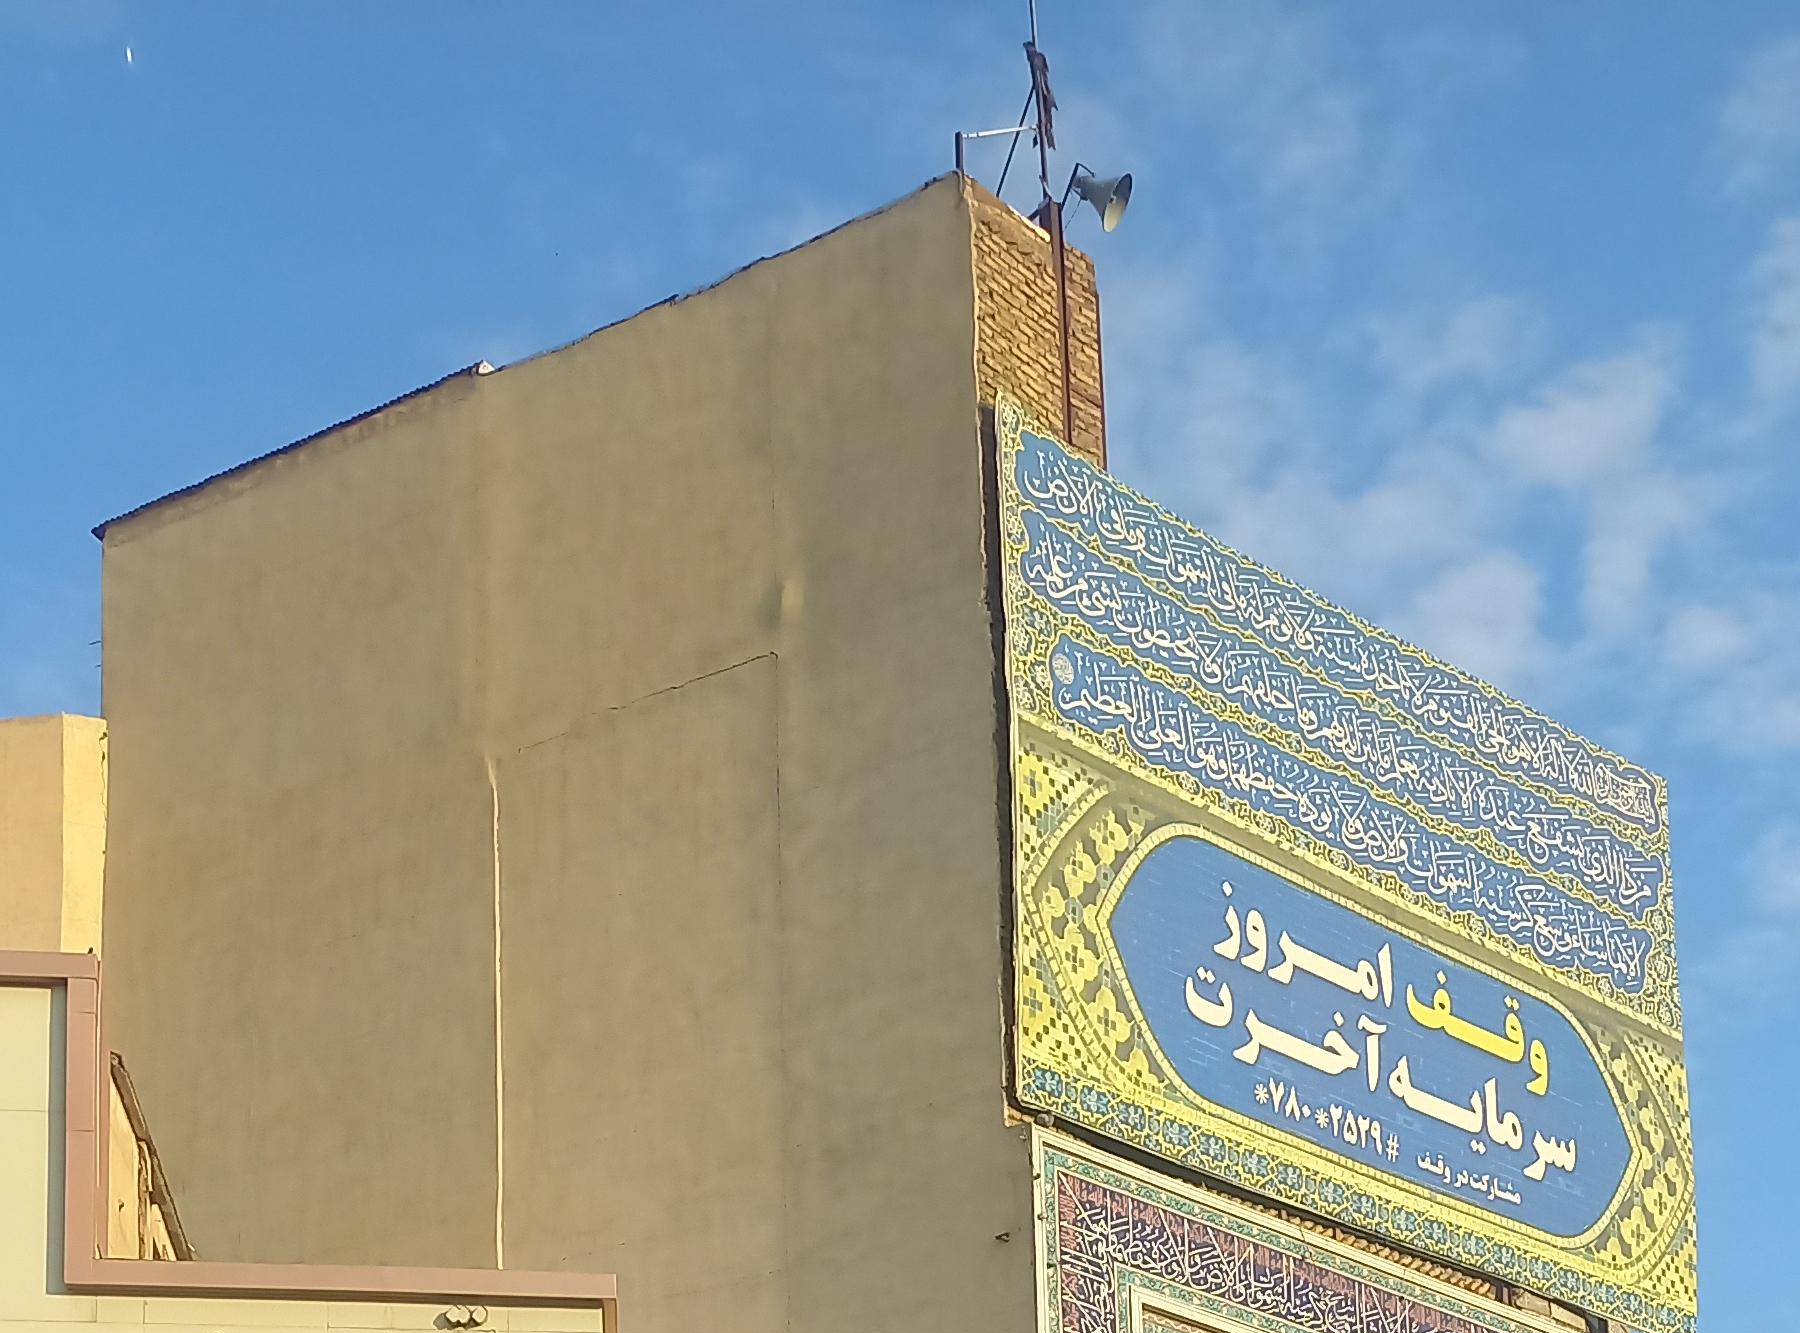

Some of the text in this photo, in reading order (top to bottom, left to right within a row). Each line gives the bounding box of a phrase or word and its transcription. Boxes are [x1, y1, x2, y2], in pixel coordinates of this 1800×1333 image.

[1184, 963, 1389, 1094] آخرت
[1214, 880, 1550, 1096] وقف امروز
[1417, 1151, 1451, 1184] وقف
